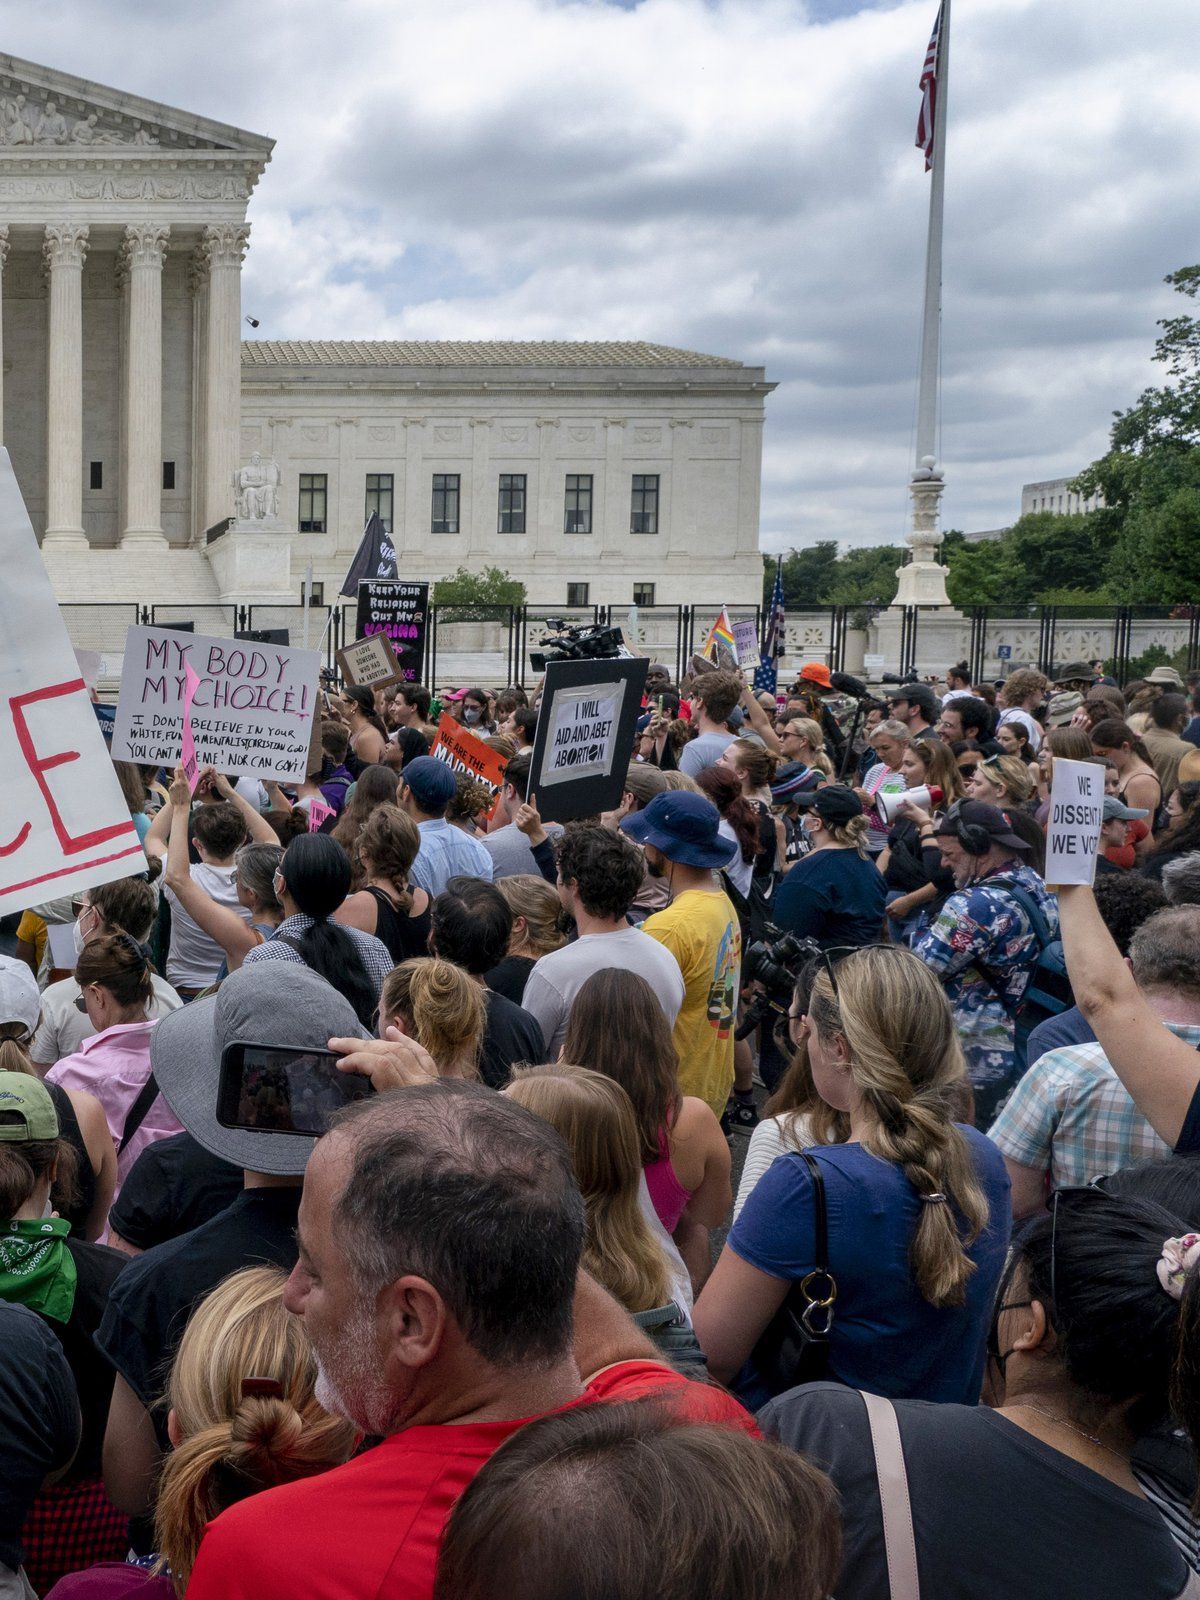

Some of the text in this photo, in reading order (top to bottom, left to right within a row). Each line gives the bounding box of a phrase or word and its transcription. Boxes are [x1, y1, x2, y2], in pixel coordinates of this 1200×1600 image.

[24, 182, 57, 195] LAW
[364, 622, 418, 638] VAGINA
[356, 653, 377, 665] SOMEONE
[360, 645, 371, 655] LOVE
[146, 638, 290, 683] MY BODY
[366, 668, 388, 680] ABORTION
[142, 676, 309, 719] MY CHOICE!
[574, 700, 600, 720] I WILL
[132, 715, 144, 725] I
[191, 717, 243, 734] BELIEVE
[246, 724, 263, 735] IN
[555, 720, 612, 746] AID AND ABET
[126, 742, 147, 758] YOU
[228, 753, 249, 766] NOR
[251, 755, 272, 768] CAN
[441, 731, 486, 773] WE ARE THE
[1077, 776, 1092, 796] WE
[1053, 804, 1097, 826] DISSENT
[1052, 834, 1076, 854] WE
